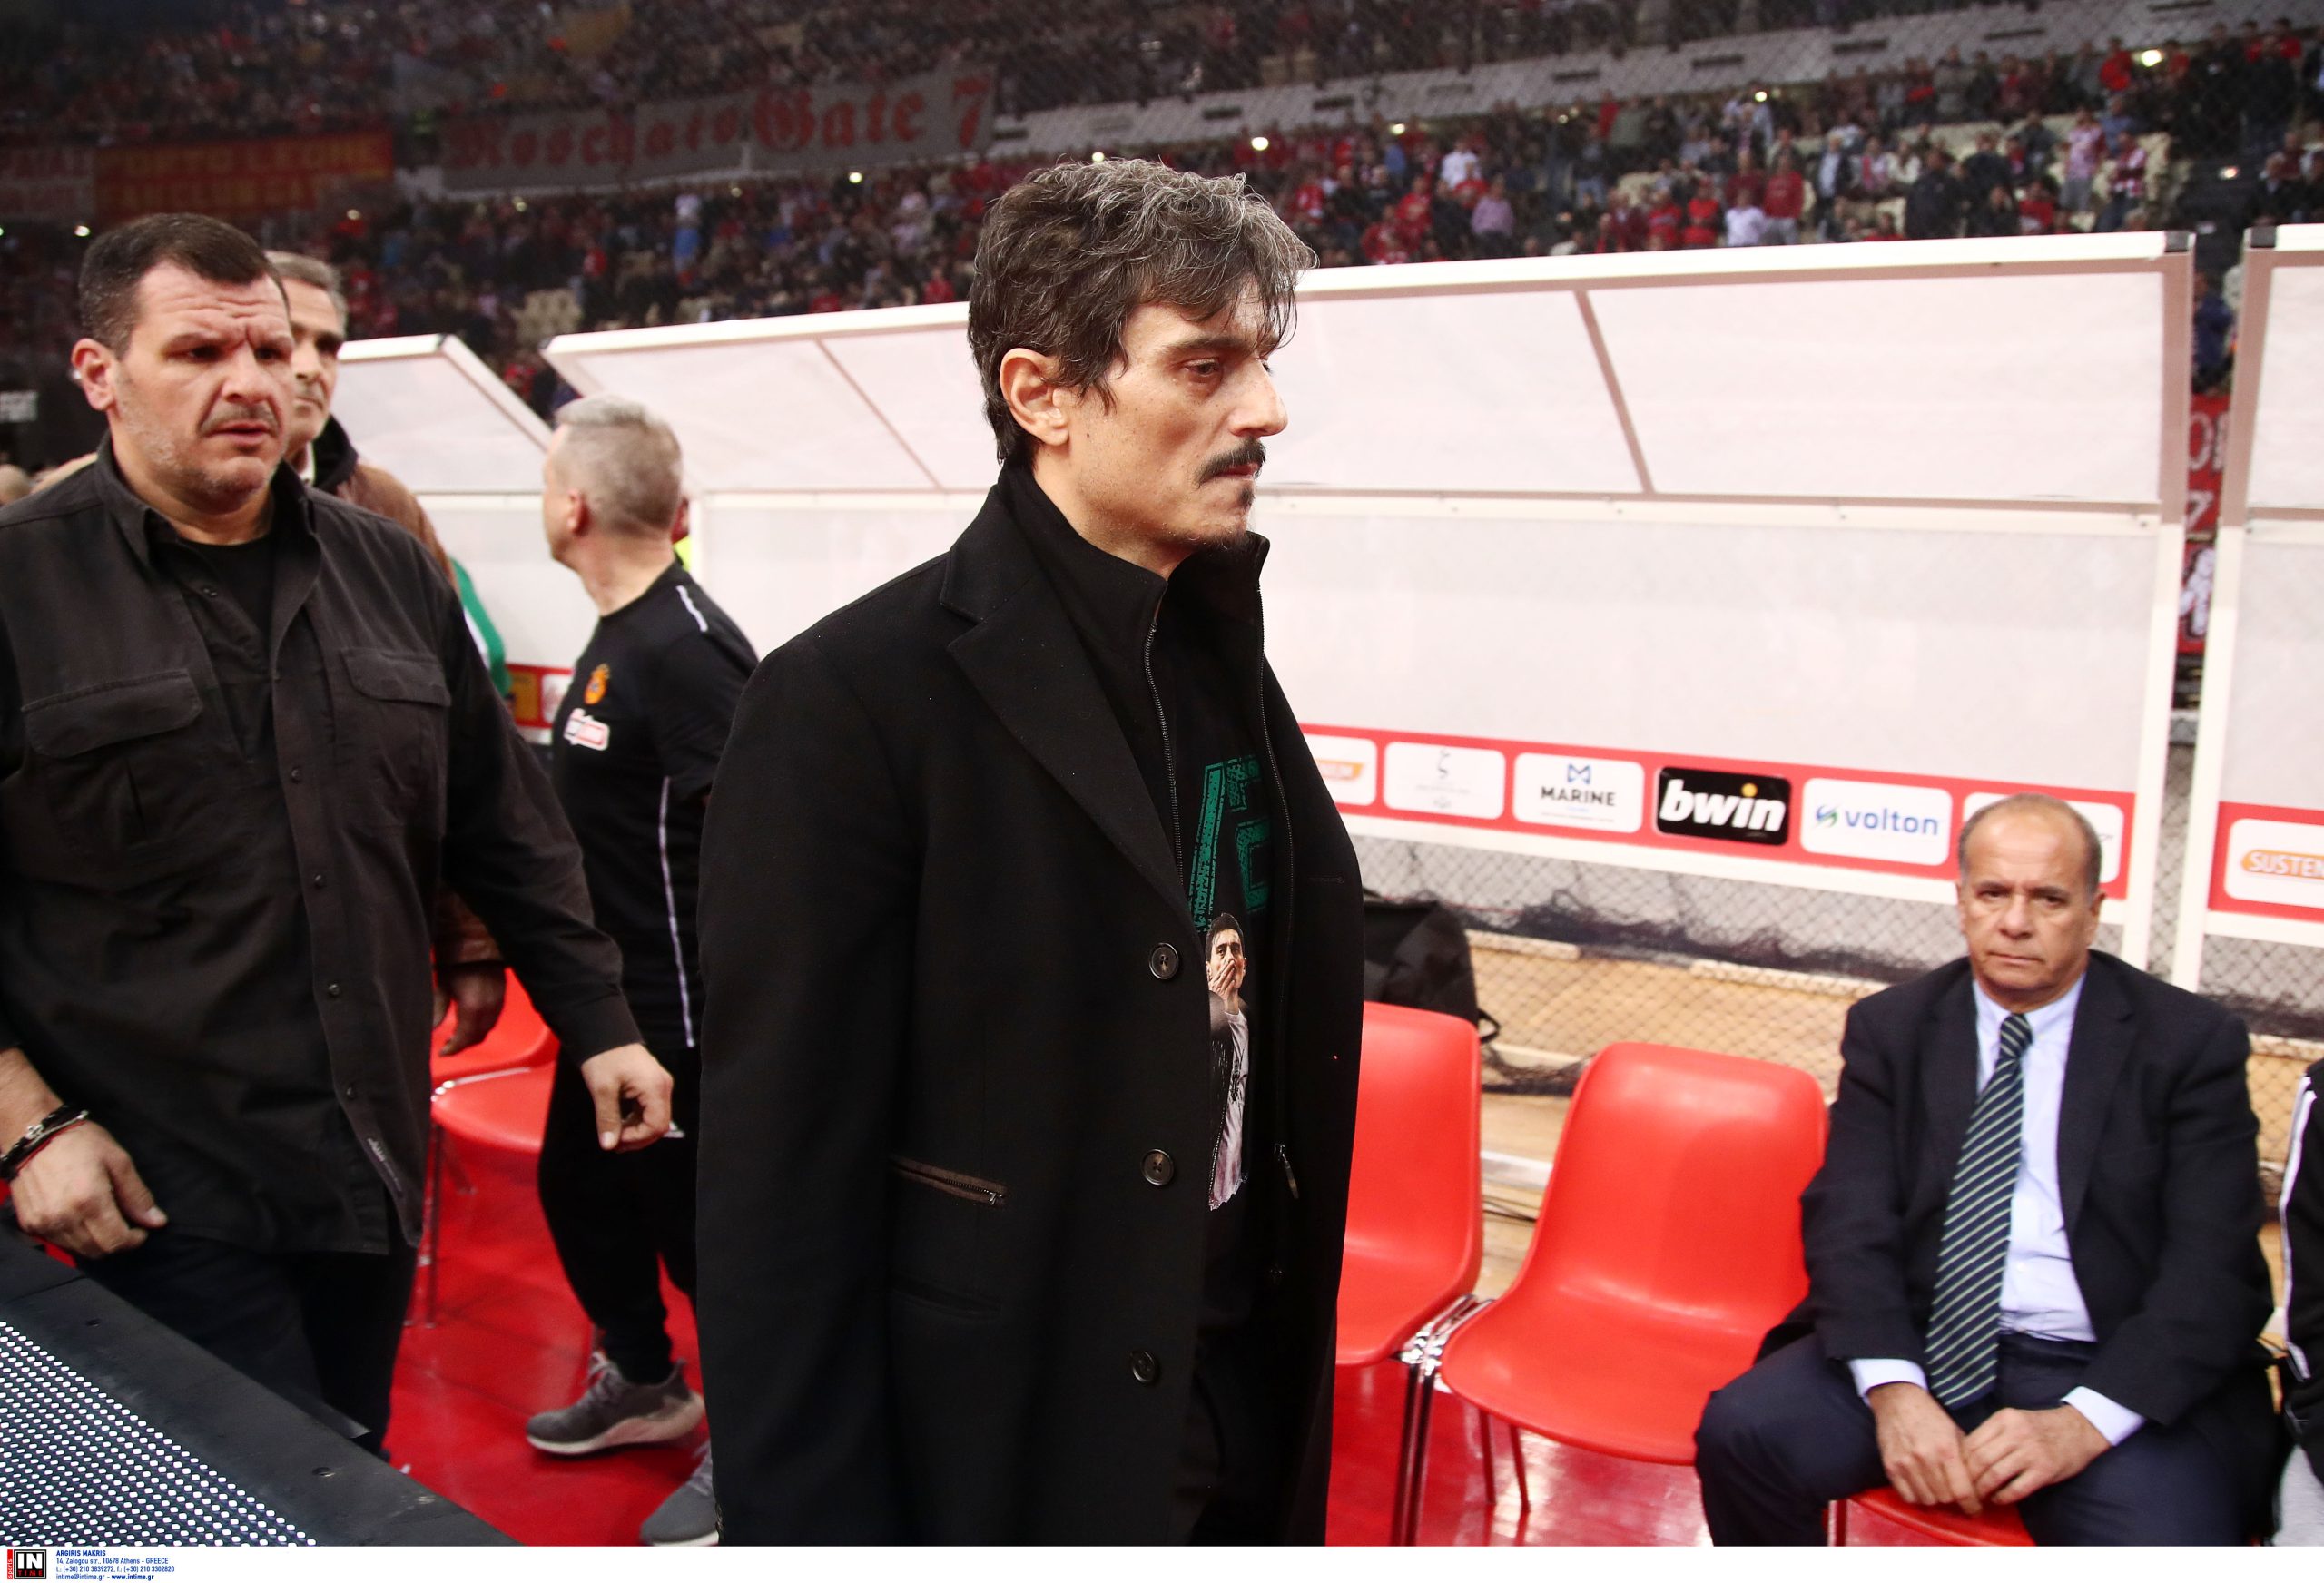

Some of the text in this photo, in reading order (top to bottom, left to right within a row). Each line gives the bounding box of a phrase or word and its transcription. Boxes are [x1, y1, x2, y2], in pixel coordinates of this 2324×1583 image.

[753, 88, 926, 152] Gate
[952, 75, 992, 149] 7
[1541, 786, 1616, 806] MARINE
[1659, 779, 1786, 831] bwin
[1845, 808, 1939, 835] volton
